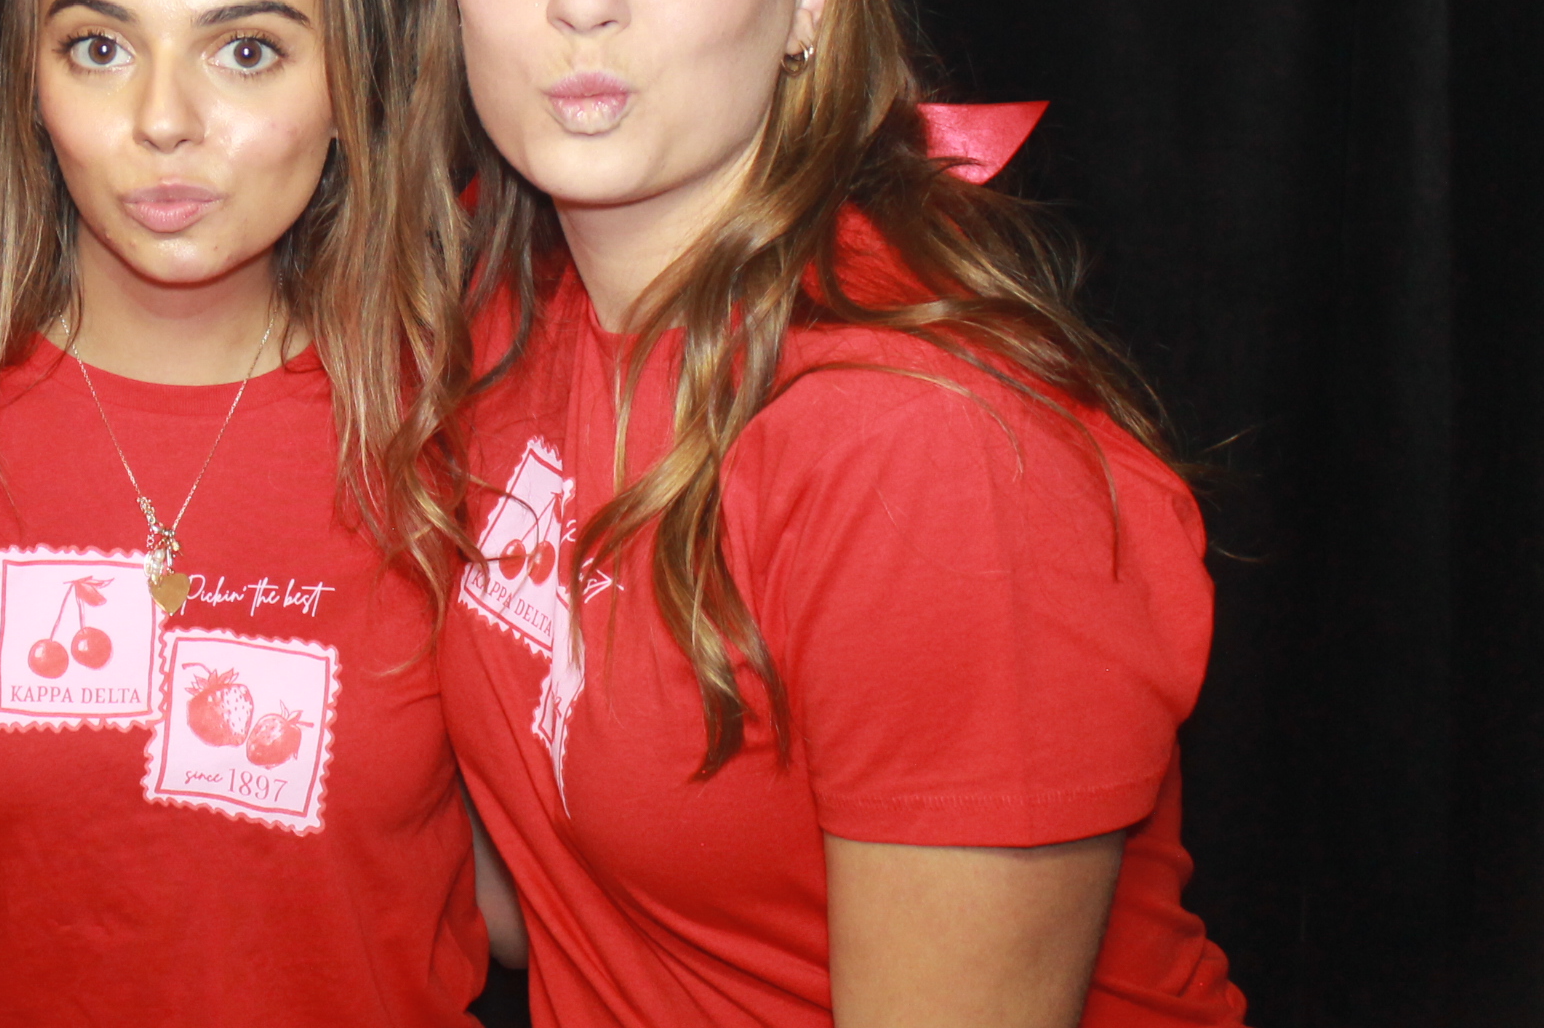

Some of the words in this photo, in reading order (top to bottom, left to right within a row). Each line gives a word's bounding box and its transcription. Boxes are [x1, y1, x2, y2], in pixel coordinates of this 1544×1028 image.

[248, 577, 281, 617] the
[283, 578, 336, 617] best
[471, 569, 511, 609] KPPA
[514, 598, 552, 638] DELTA
[10, 684, 74, 704] KAPPA
[81, 687, 142, 705] DELTA
[184, 769, 224, 785] since
[227, 768, 289, 803] 1897
